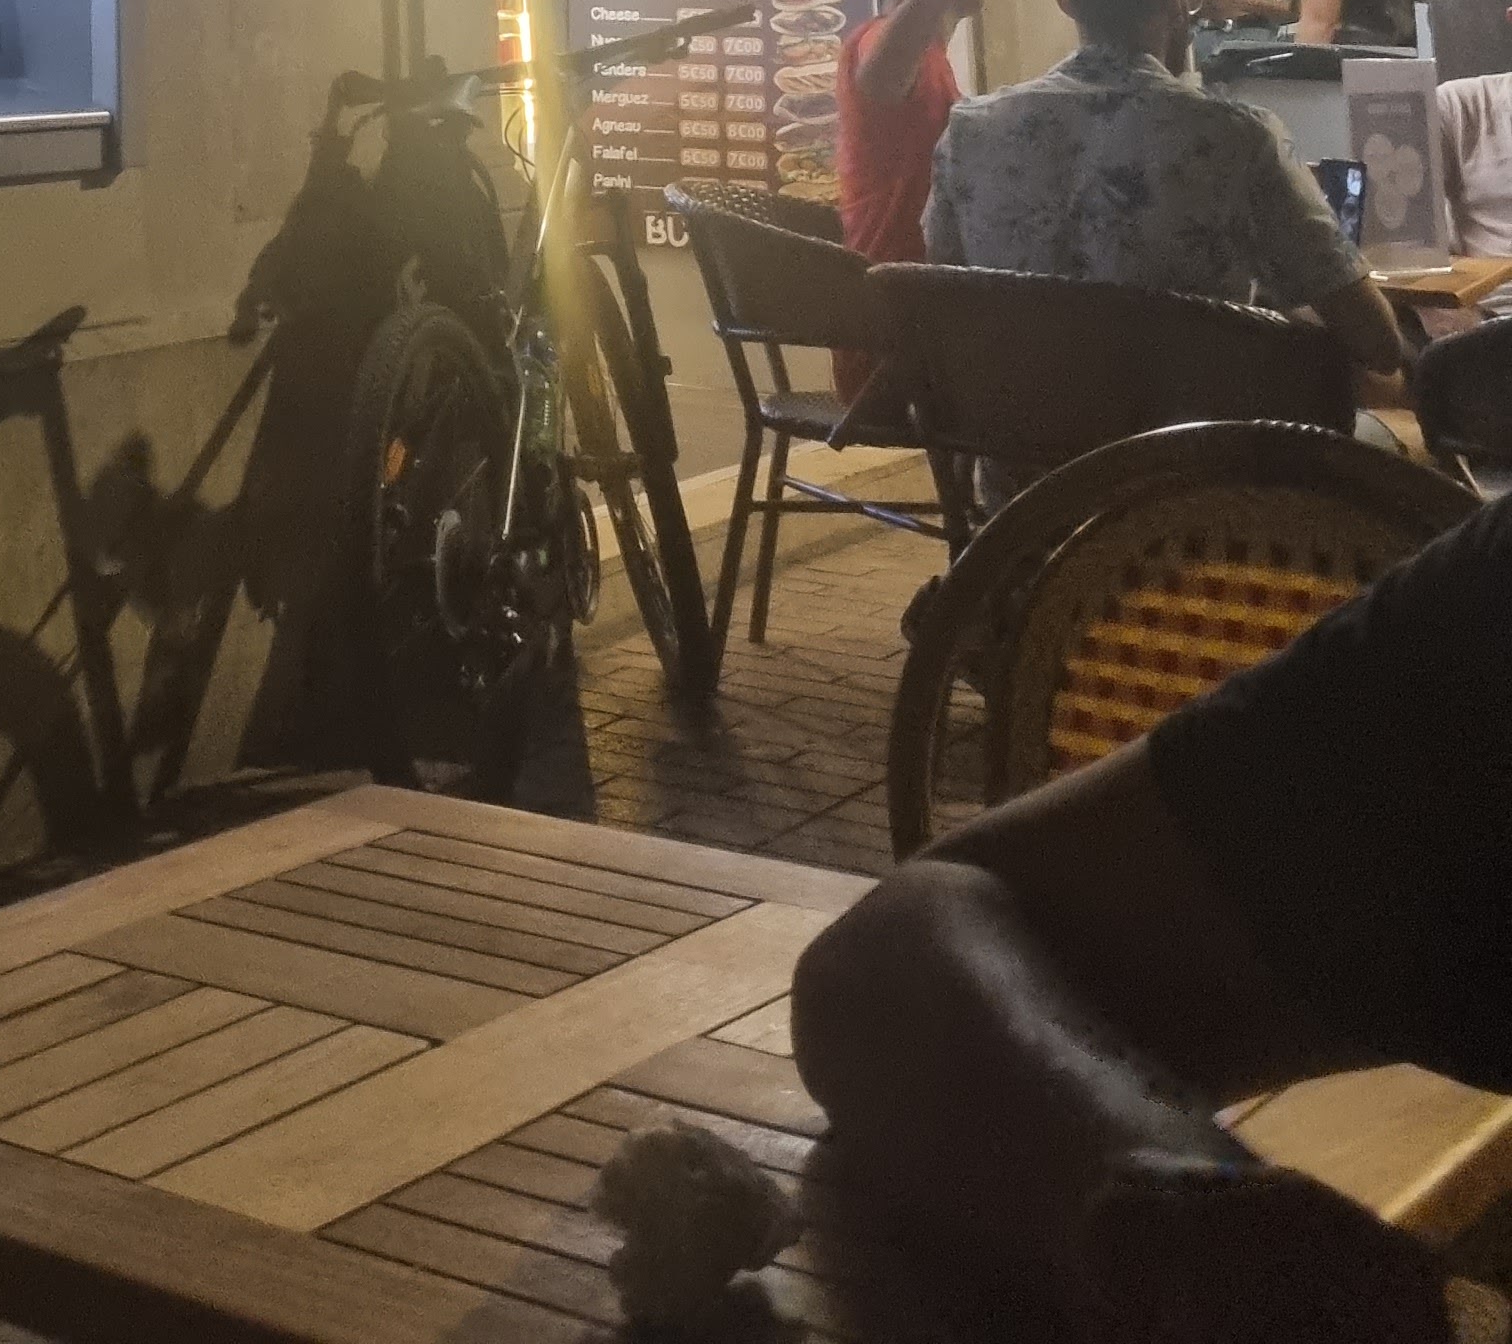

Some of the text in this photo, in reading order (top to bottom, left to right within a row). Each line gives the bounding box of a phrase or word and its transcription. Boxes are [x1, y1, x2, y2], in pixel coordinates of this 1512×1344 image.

[590, 6, 640, 21] Cheese
[592, 89, 649, 106] Merguez
[592, 118, 641, 135] Agneau
[592, 145, 638, 160] Falafel
[593, 173, 633, 188] Panini
